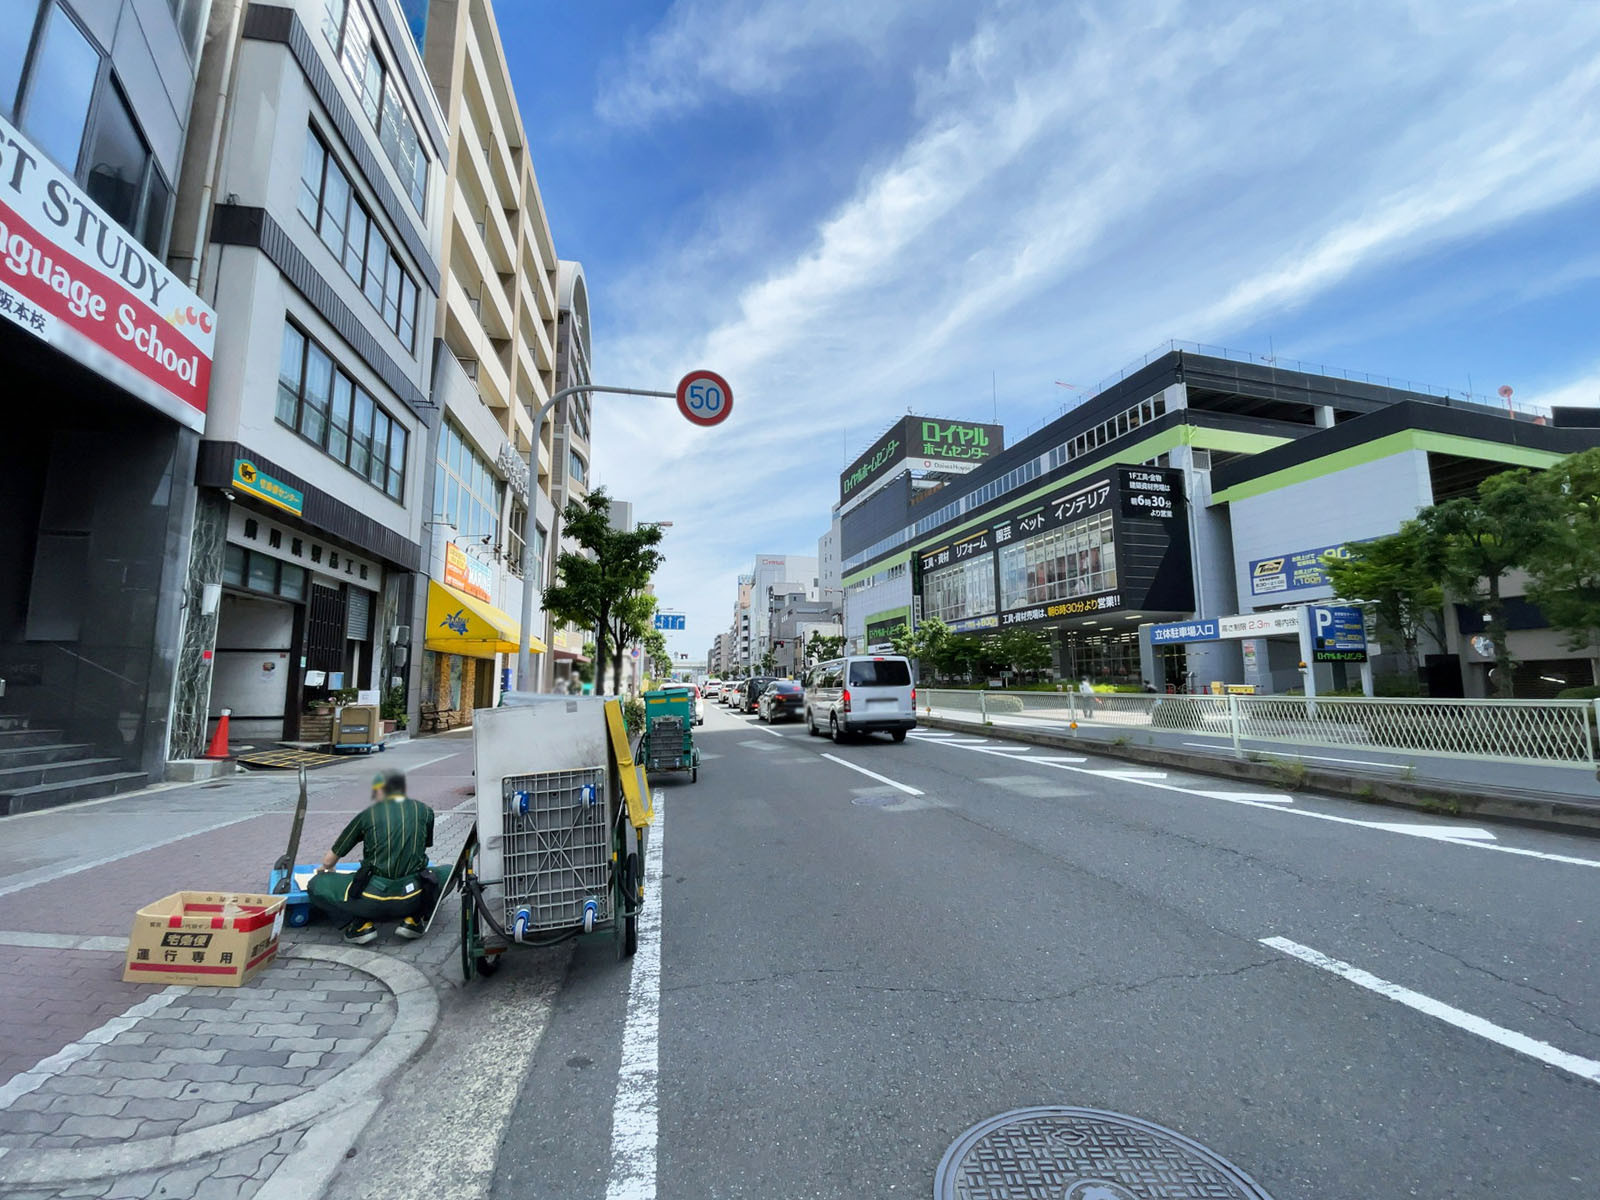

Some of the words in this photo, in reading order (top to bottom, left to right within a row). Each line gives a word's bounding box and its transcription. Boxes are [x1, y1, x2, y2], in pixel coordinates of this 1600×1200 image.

[42, 179, 170, 308] STUDY
[116, 303, 199, 388] School
[690, 385, 720, 411] 50
[922, 421, 989, 447] ロイヤル
[923, 442, 989, 459] ホームセンター
[843, 440, 900, 494] ロイヤルホームセンター
[956, 536, 987, 558] リフォーム
[996, 526, 1011, 543] 園芸
[1019, 514, 1045, 531] ペット
[1055, 486, 1110, 520] インテリア
[1155, 624, 1214, 640] 立体駐車場入口
[1248, 620, 1271, 630] 2.3m
[1315, 609, 1332, 637] P
